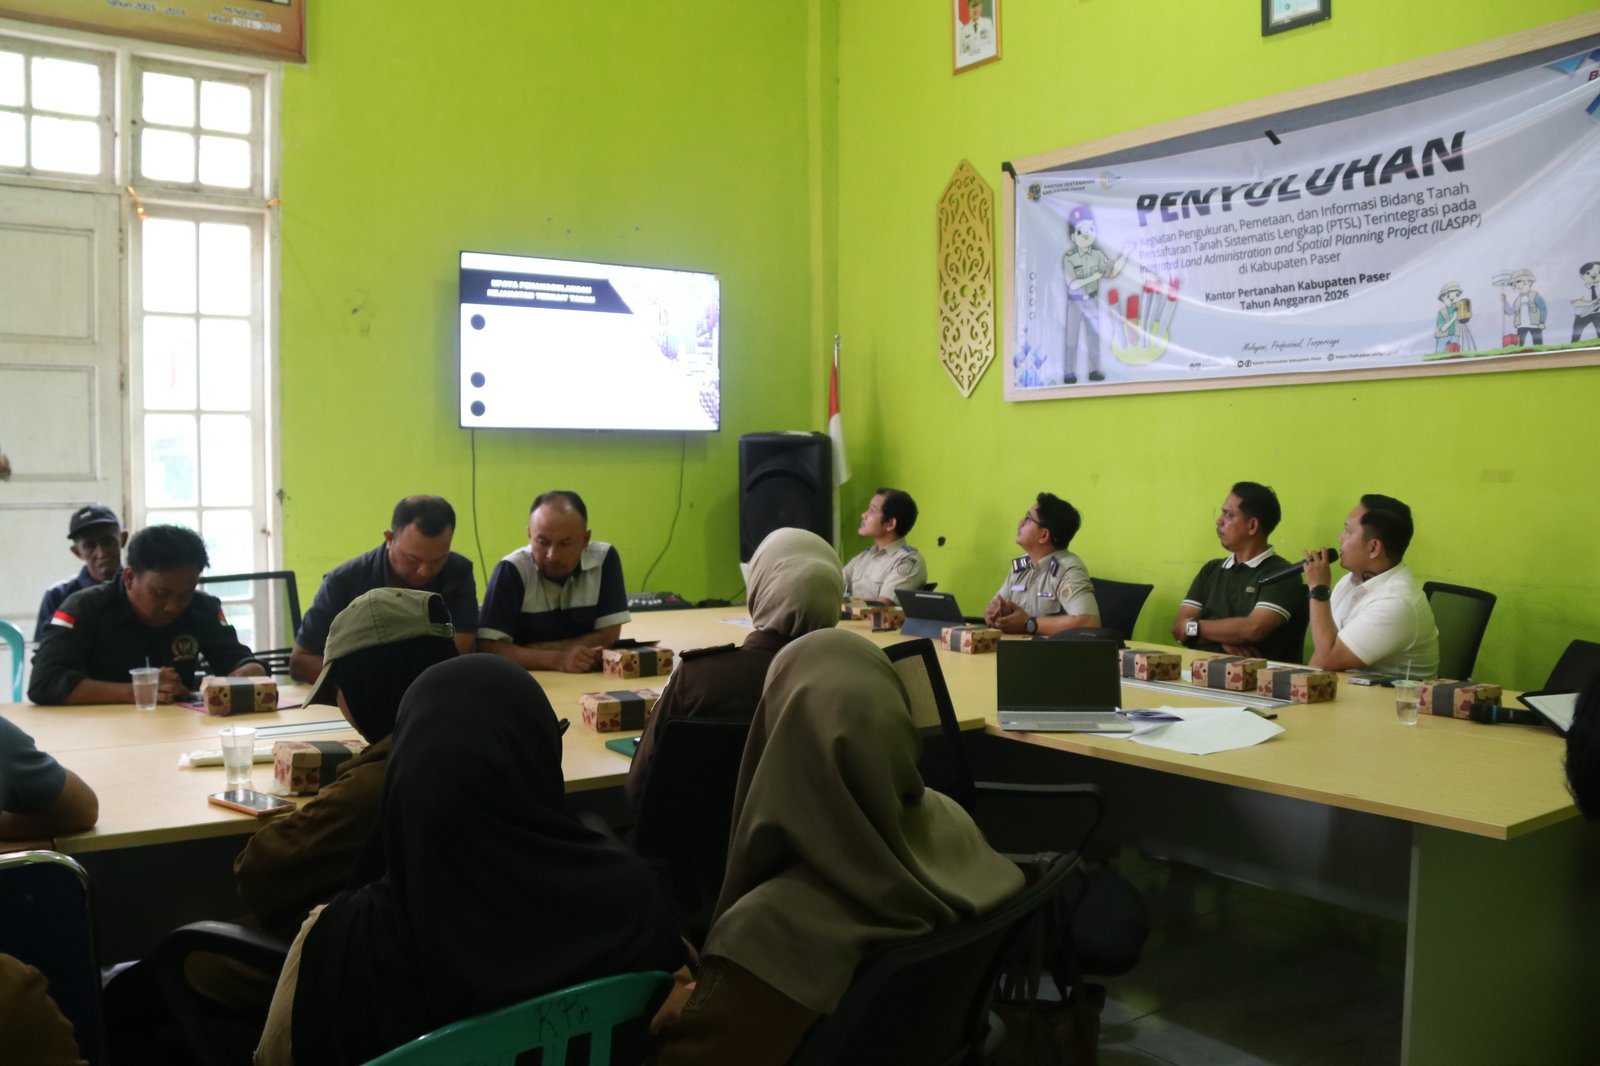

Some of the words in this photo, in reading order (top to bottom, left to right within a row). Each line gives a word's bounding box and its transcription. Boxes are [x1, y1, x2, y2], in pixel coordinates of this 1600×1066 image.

[1136, 130, 1466, 227] PENYULUHAN
[1178, 222, 1238, 241] Pengukuran,
[1239, 211, 1295, 231] Pemetaan,
[1297, 206, 1319, 220] dan
[1321, 194, 1377, 218] Informasi
[1380, 189, 1425, 208] Bidang
[1427, 181, 1470, 199] Tanah
[1193, 238, 1223, 252] Tanah
[1225, 228, 1276, 248] Sistematis
[1278, 221, 1324, 240] Lengkap
[1326, 215, 1362, 234] (PTSL)
[1365, 205, 1439, 226] Terintegrasi
[1442, 197, 1477, 218] pada
[1181, 254, 1203, 268] Land
[1204, 246, 1272, 265] Administration
[1274, 242, 1295, 255] and
[1297, 236, 1333, 252] Spatial
[1335, 226, 1385, 248] Planning
[1387, 222, 1429, 240] Project
[1431, 212, 1482, 235] (ILASPP)
[1239, 263, 1249, 275] di
[1251, 255, 1308, 273] Kabupaten
[1310, 251, 1341, 265] Paser
[1205, 290, 1236, 302] Kantor
[1237, 283, 1296, 299] Pertanahan
[1297, 275, 1357, 292] Kabupaten
[1359, 271, 1391, 284] Paser
[1240, 299, 1272, 311] Tahun
[1273, 294, 1323, 309] Anggaran
[1324, 289, 1349, 302] 2026
